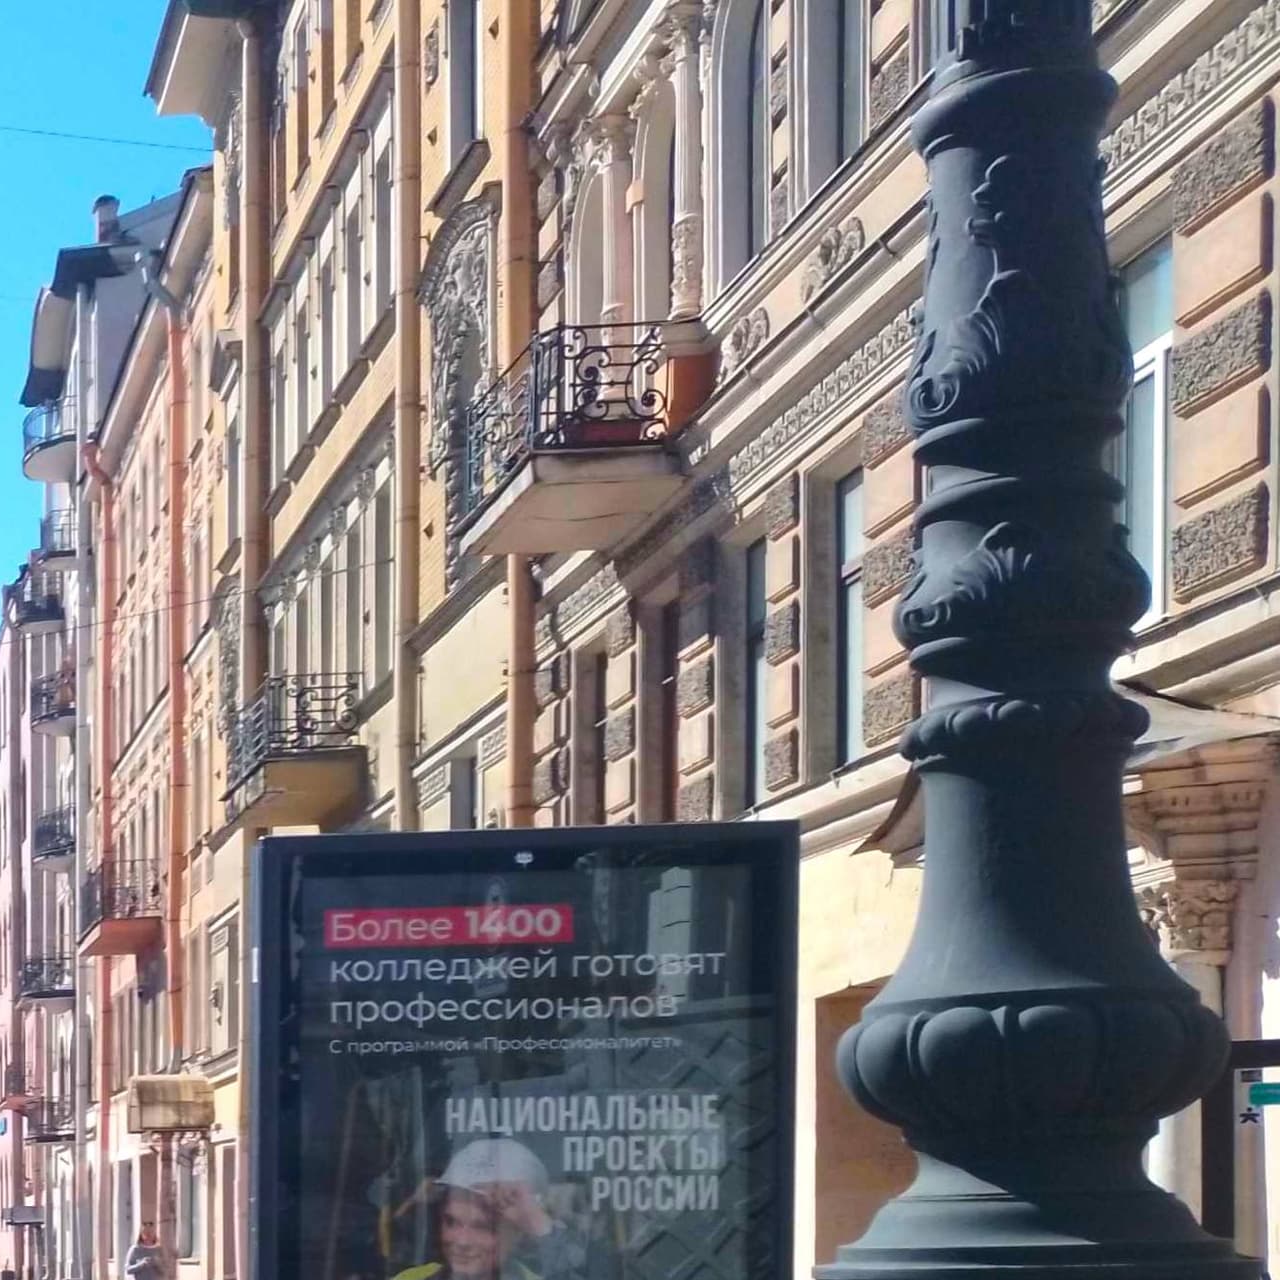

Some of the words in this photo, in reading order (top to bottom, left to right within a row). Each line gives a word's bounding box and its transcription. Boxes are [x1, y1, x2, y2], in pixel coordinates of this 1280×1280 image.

[331, 912, 454, 941] Более
[464, 908, 562, 938] 1400
[330, 948, 558, 984] колледжей
[571, 951, 726, 979] готовят
[330, 991, 680, 1030] профессионалов
[329, 1040, 341, 1054] С
[348, 1036, 469, 1055] программой
[473, 1034, 682, 1054] «Профессионалитет»
[445, 1094, 721, 1136] НАЦИОНАЛЬНЫЕ
[563, 1134, 720, 1172] ПРОЕКТЫ
[592, 1175, 720, 1212] РОССИИ
